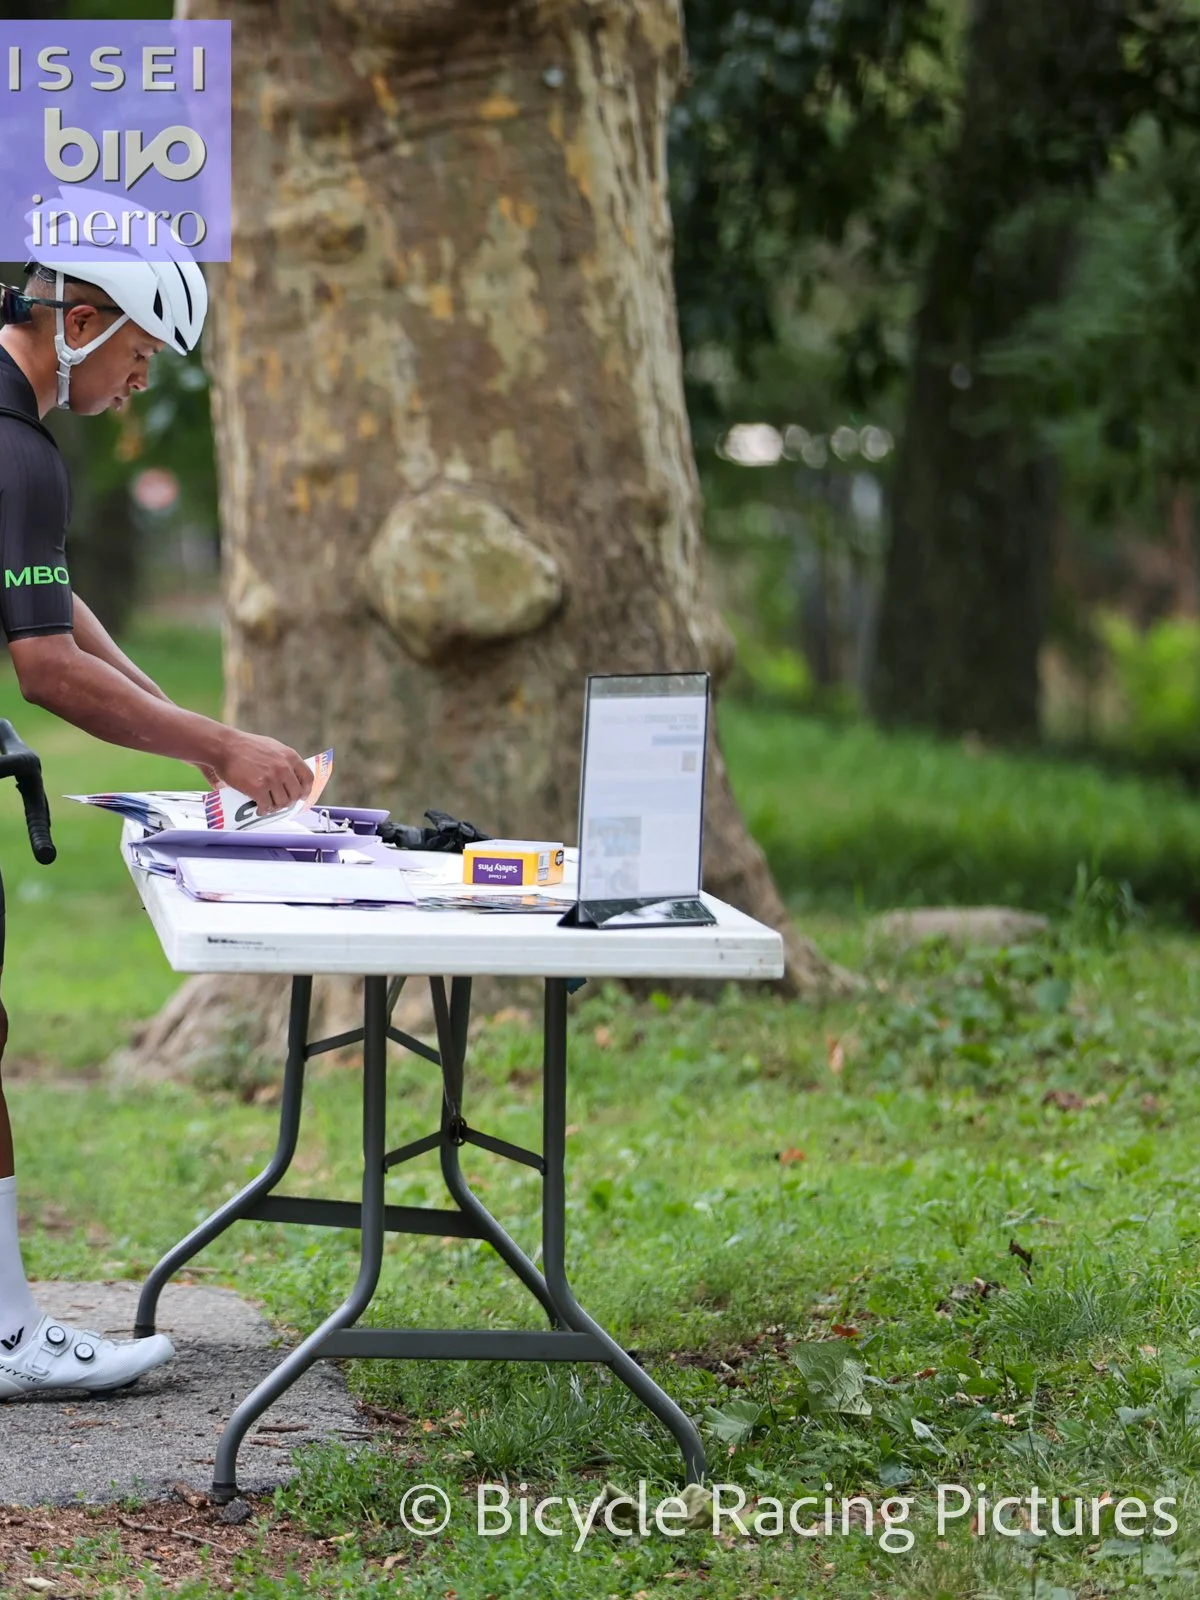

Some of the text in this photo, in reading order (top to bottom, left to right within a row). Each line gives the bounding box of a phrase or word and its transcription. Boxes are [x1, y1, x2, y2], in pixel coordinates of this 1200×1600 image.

[4, 565, 70, 589] MBO
[477, 862, 518, 874] Safety Pins
